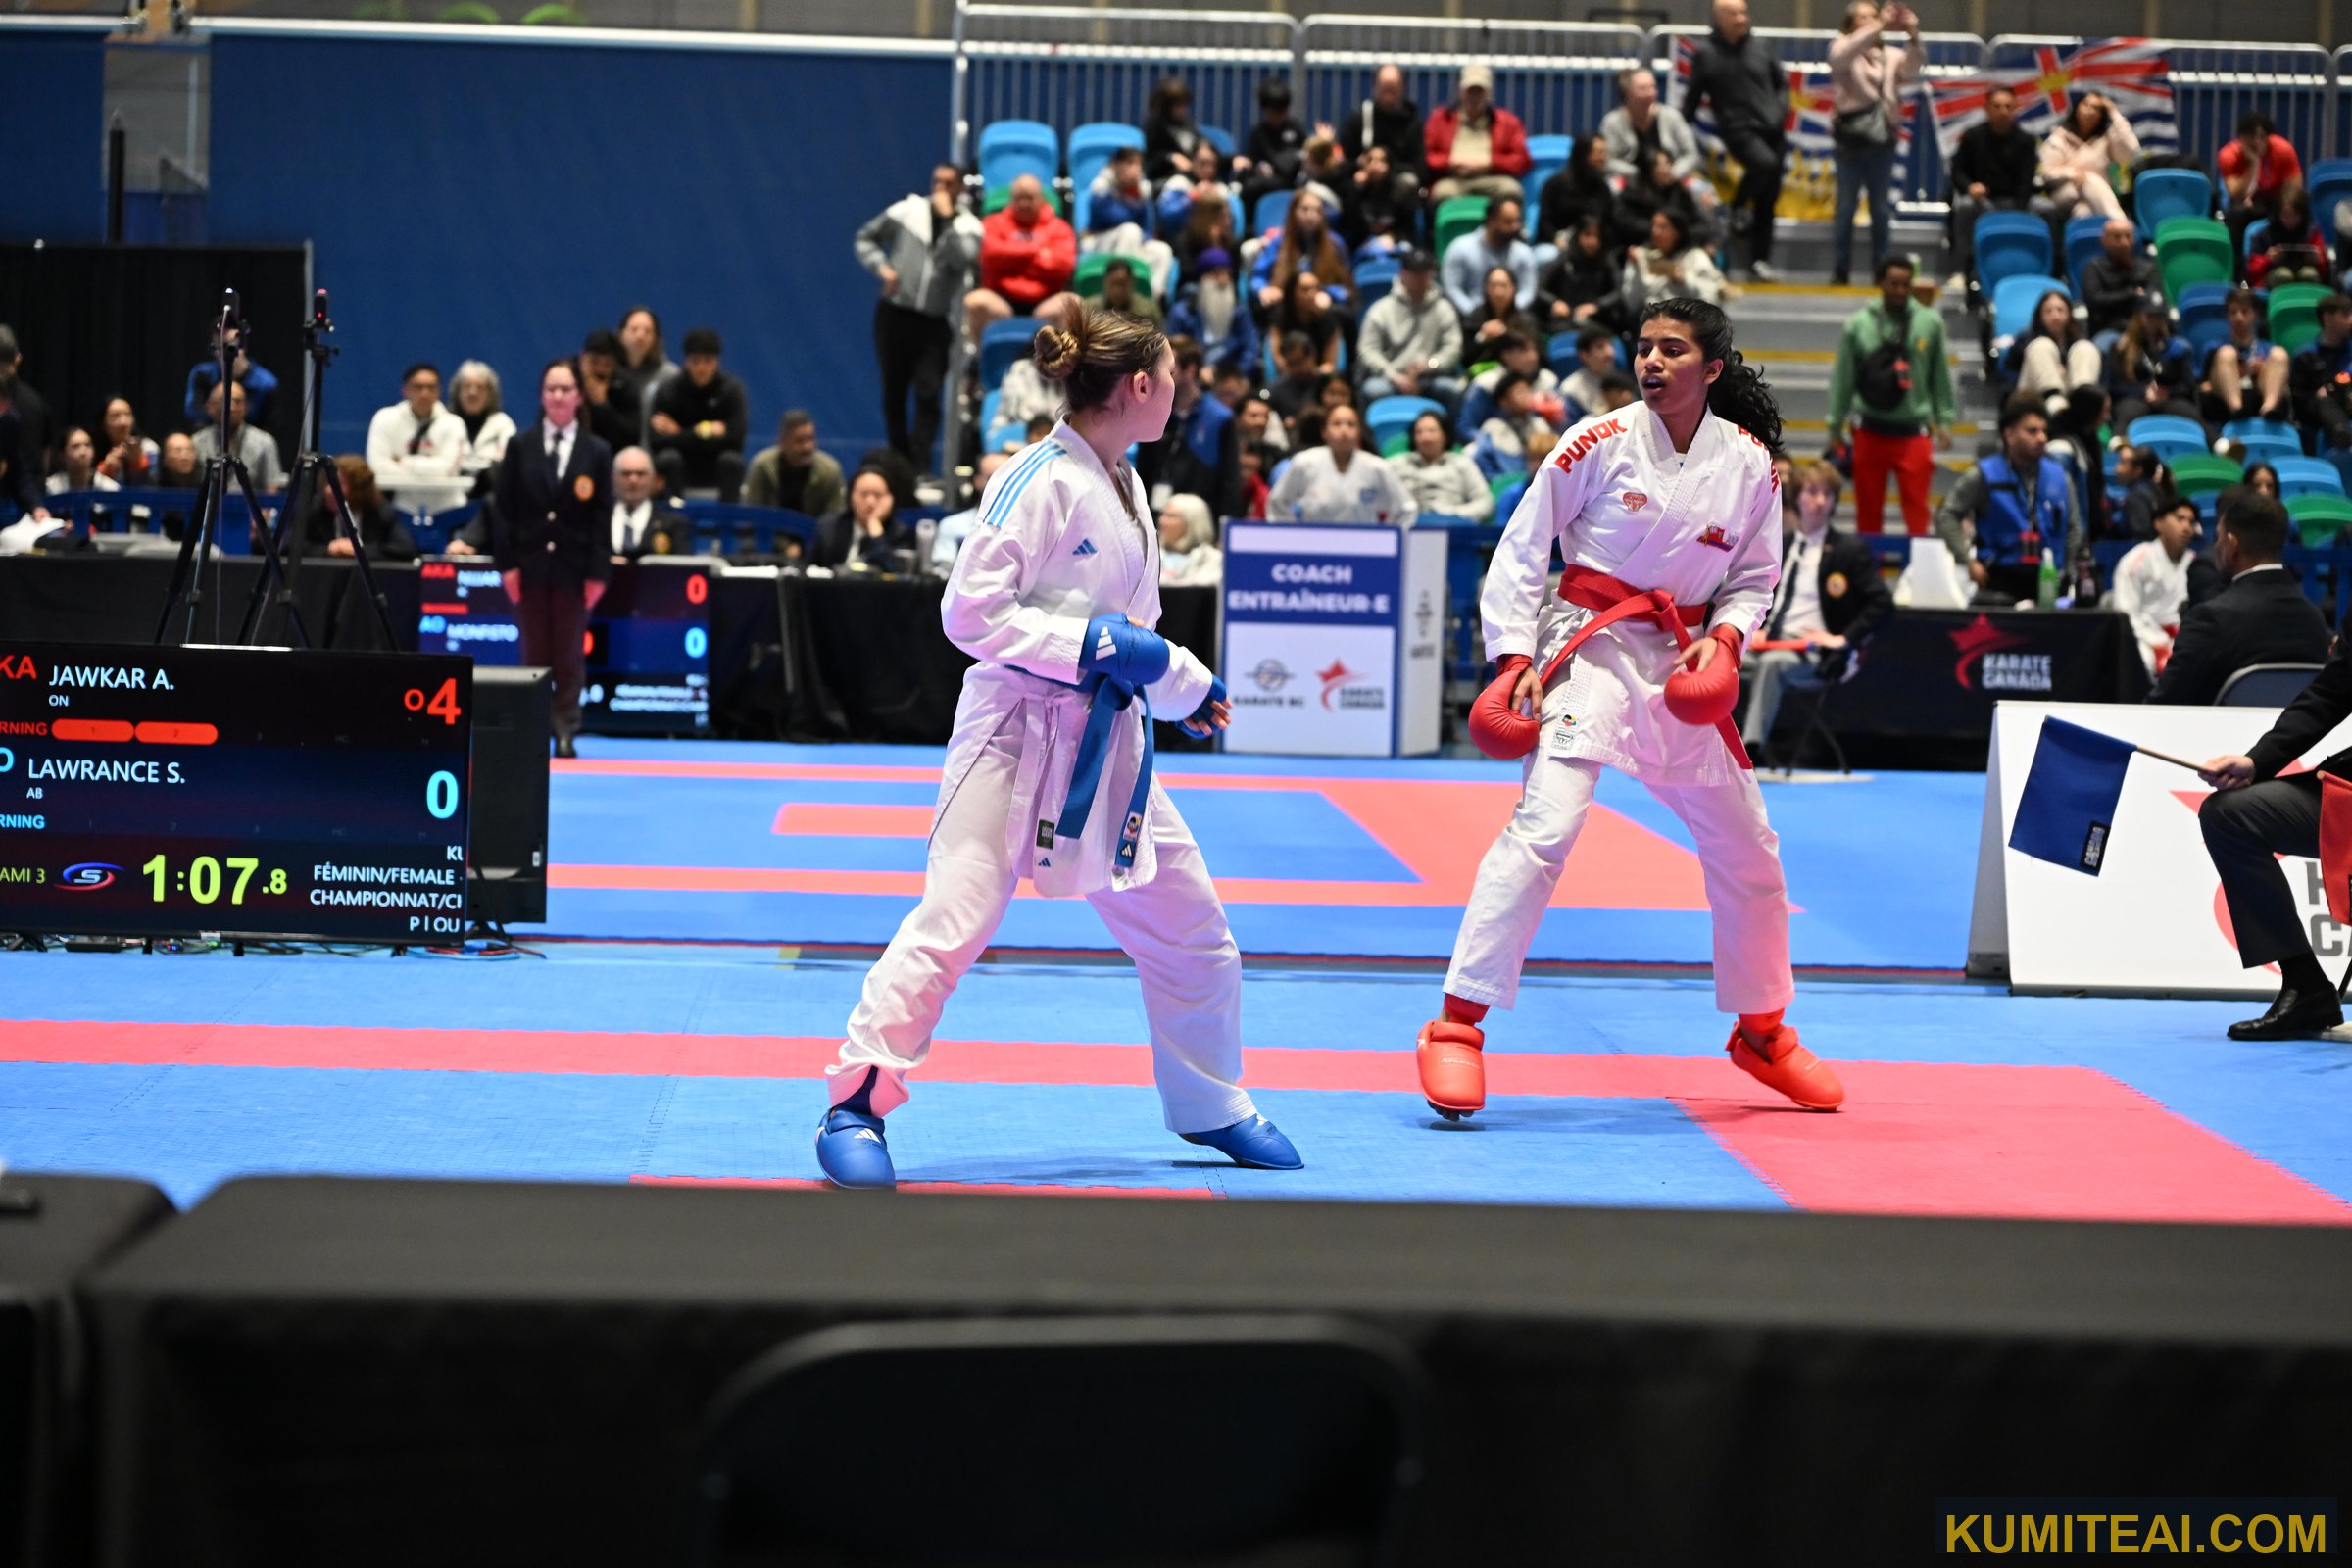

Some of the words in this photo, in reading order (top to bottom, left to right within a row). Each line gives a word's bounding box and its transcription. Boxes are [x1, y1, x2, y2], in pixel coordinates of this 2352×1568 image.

[1271, 564, 1352, 584] COACH
[686, 574, 708, 605] 0
[684, 627, 708, 659] 0
[1983, 654, 2051, 671] KARATE
[49, 665, 146, 689] JAWKAR
[152, 668, 174, 690] A.
[1982, 670, 2052, 691] CANADA
[49, 695, 69, 707] ON
[28, 758, 160, 783] LAWRANCE
[167, 762, 186, 784] S.
[26, 787, 43, 799] AB
[426, 770, 459, 819] 0
[36, 868, 46, 884] 3
[314, 861, 455, 885] FÉMININ/FEMALE
